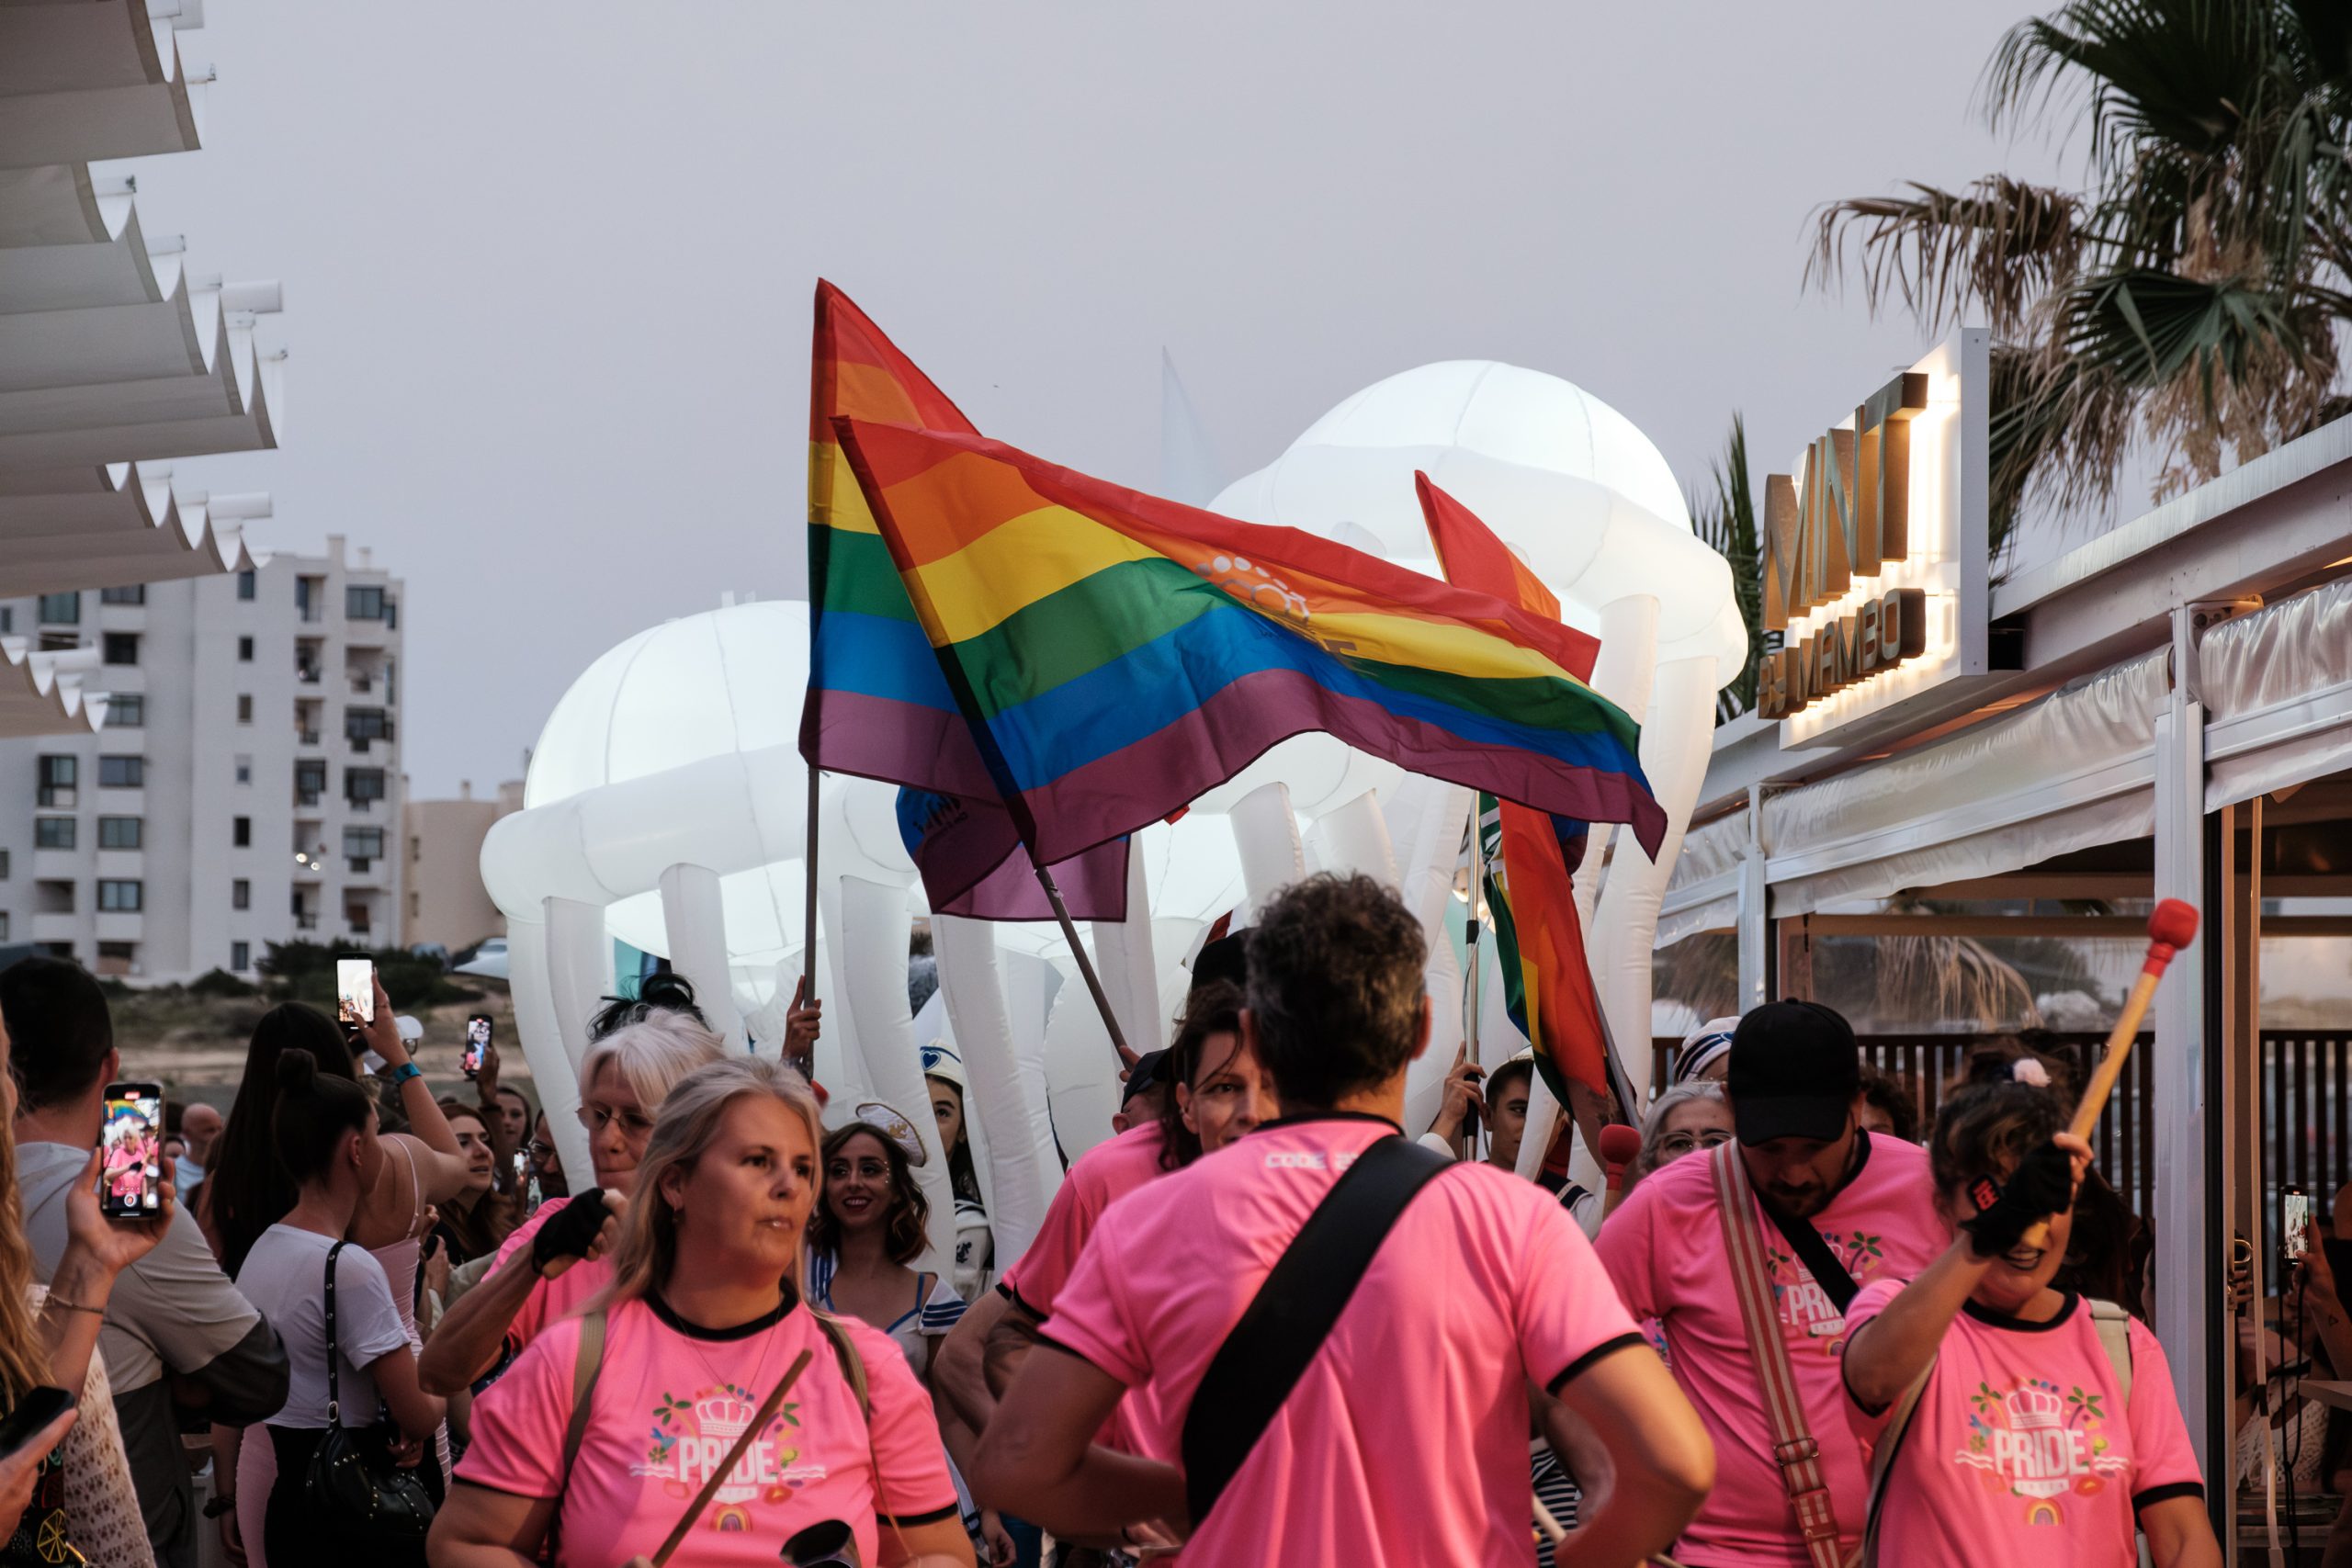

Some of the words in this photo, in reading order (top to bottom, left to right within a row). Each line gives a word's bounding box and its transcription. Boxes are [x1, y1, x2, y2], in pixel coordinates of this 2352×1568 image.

[1761, 373, 1928, 630] MINT
[1797, 589, 1926, 701] MAMBO
[1994, 1428, 2089, 1478] PRIDE
